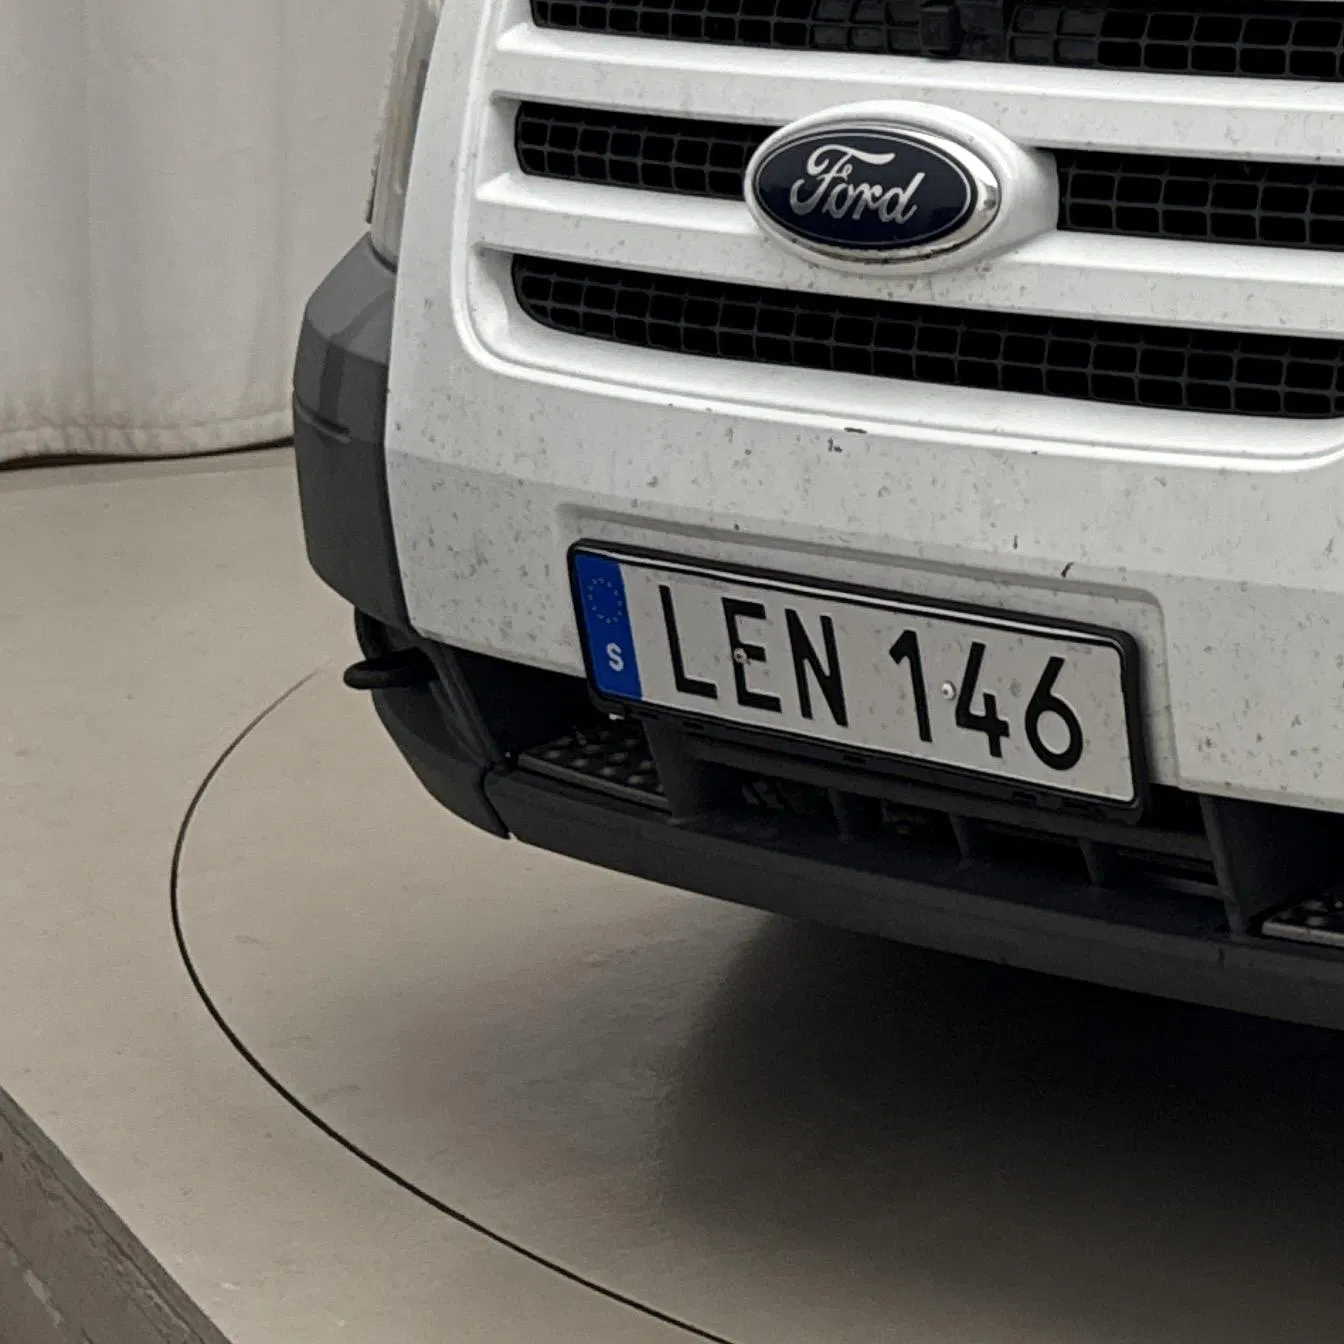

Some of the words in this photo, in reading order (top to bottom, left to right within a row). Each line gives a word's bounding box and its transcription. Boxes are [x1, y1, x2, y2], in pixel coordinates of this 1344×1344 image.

[790, 144, 925, 223] Ford
[606, 642, 624, 671] S
[658, 584, 849, 727] LEN
[889, 628, 1084, 771] 146
